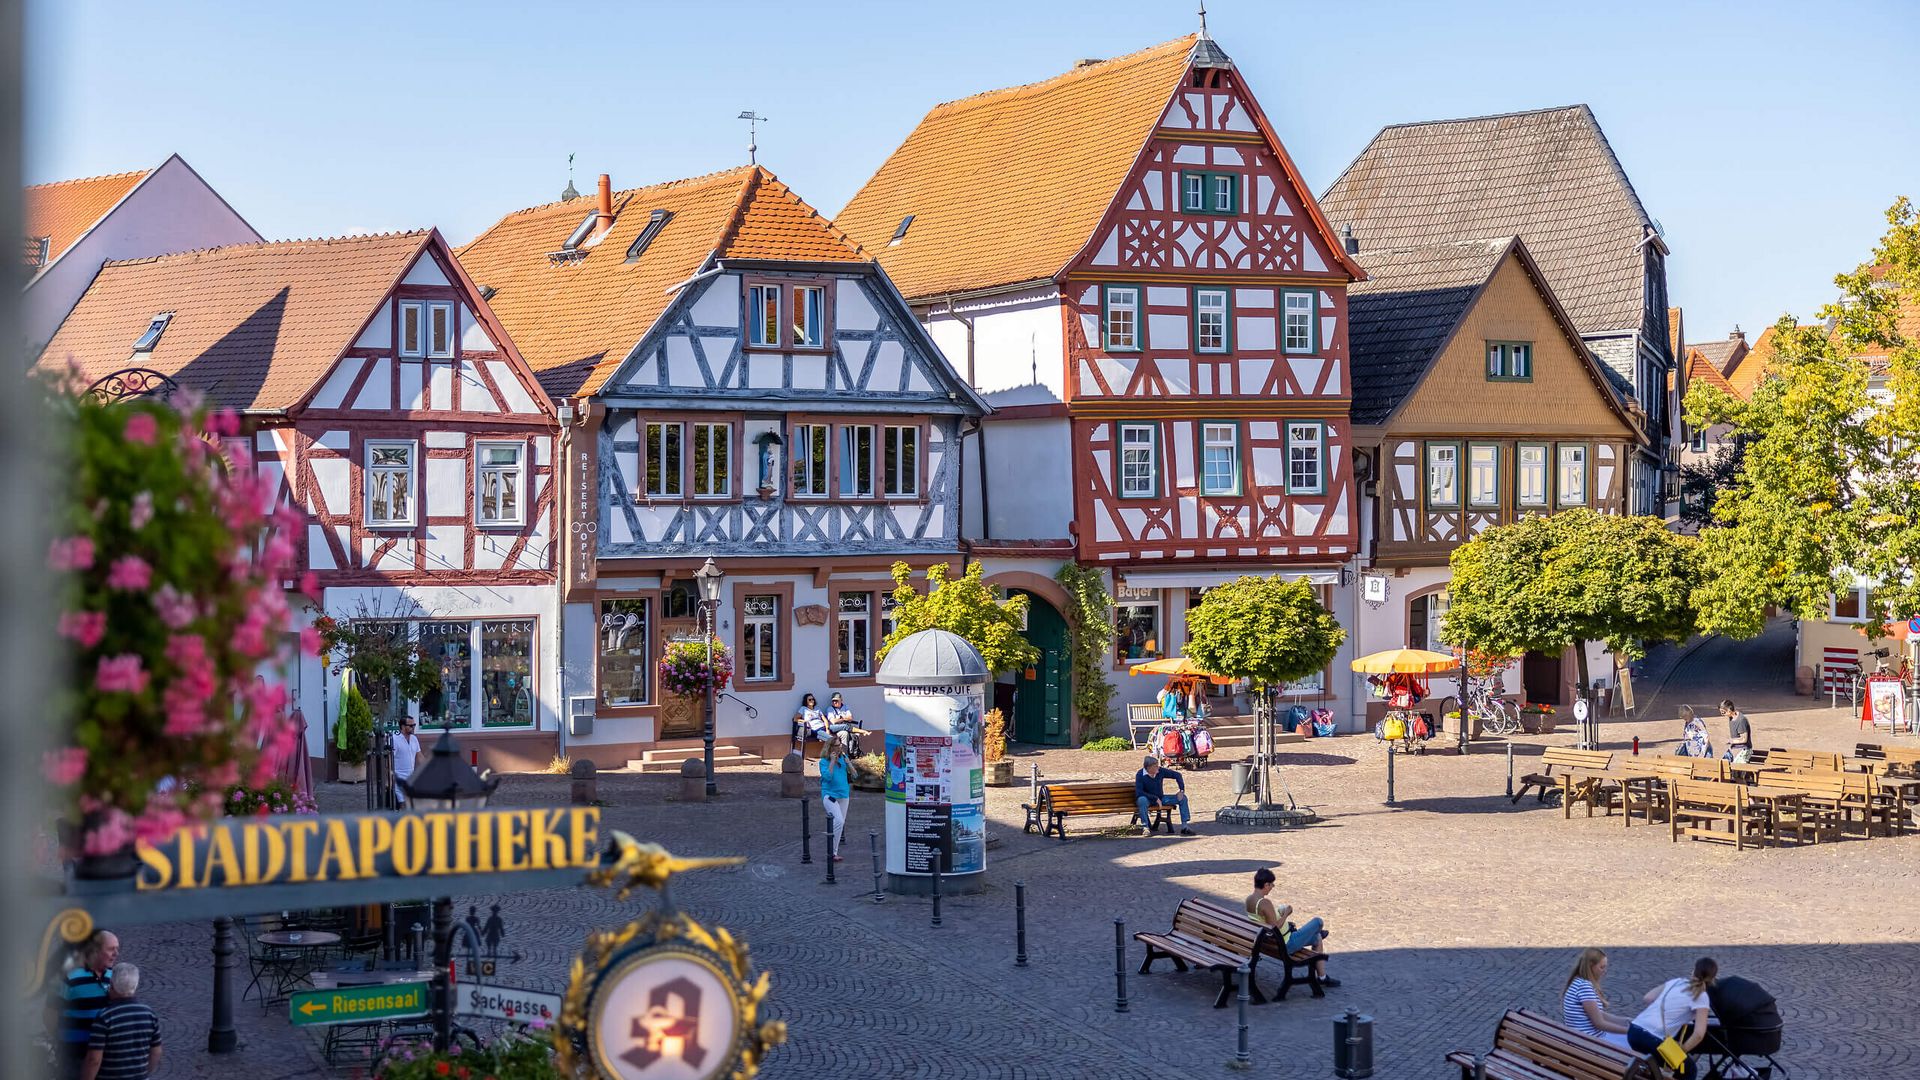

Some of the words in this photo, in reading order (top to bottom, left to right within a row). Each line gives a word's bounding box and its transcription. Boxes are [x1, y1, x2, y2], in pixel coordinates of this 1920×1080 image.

[580, 532, 588, 580] OPTIK
[423, 623, 468, 635] STEIN
[485, 622, 531, 634] WERK
[136, 807, 601, 891] STADTAPOTHEKE
[332, 989, 419, 1014] Riesensaal
[470, 990, 549, 1016] Sackgasse
